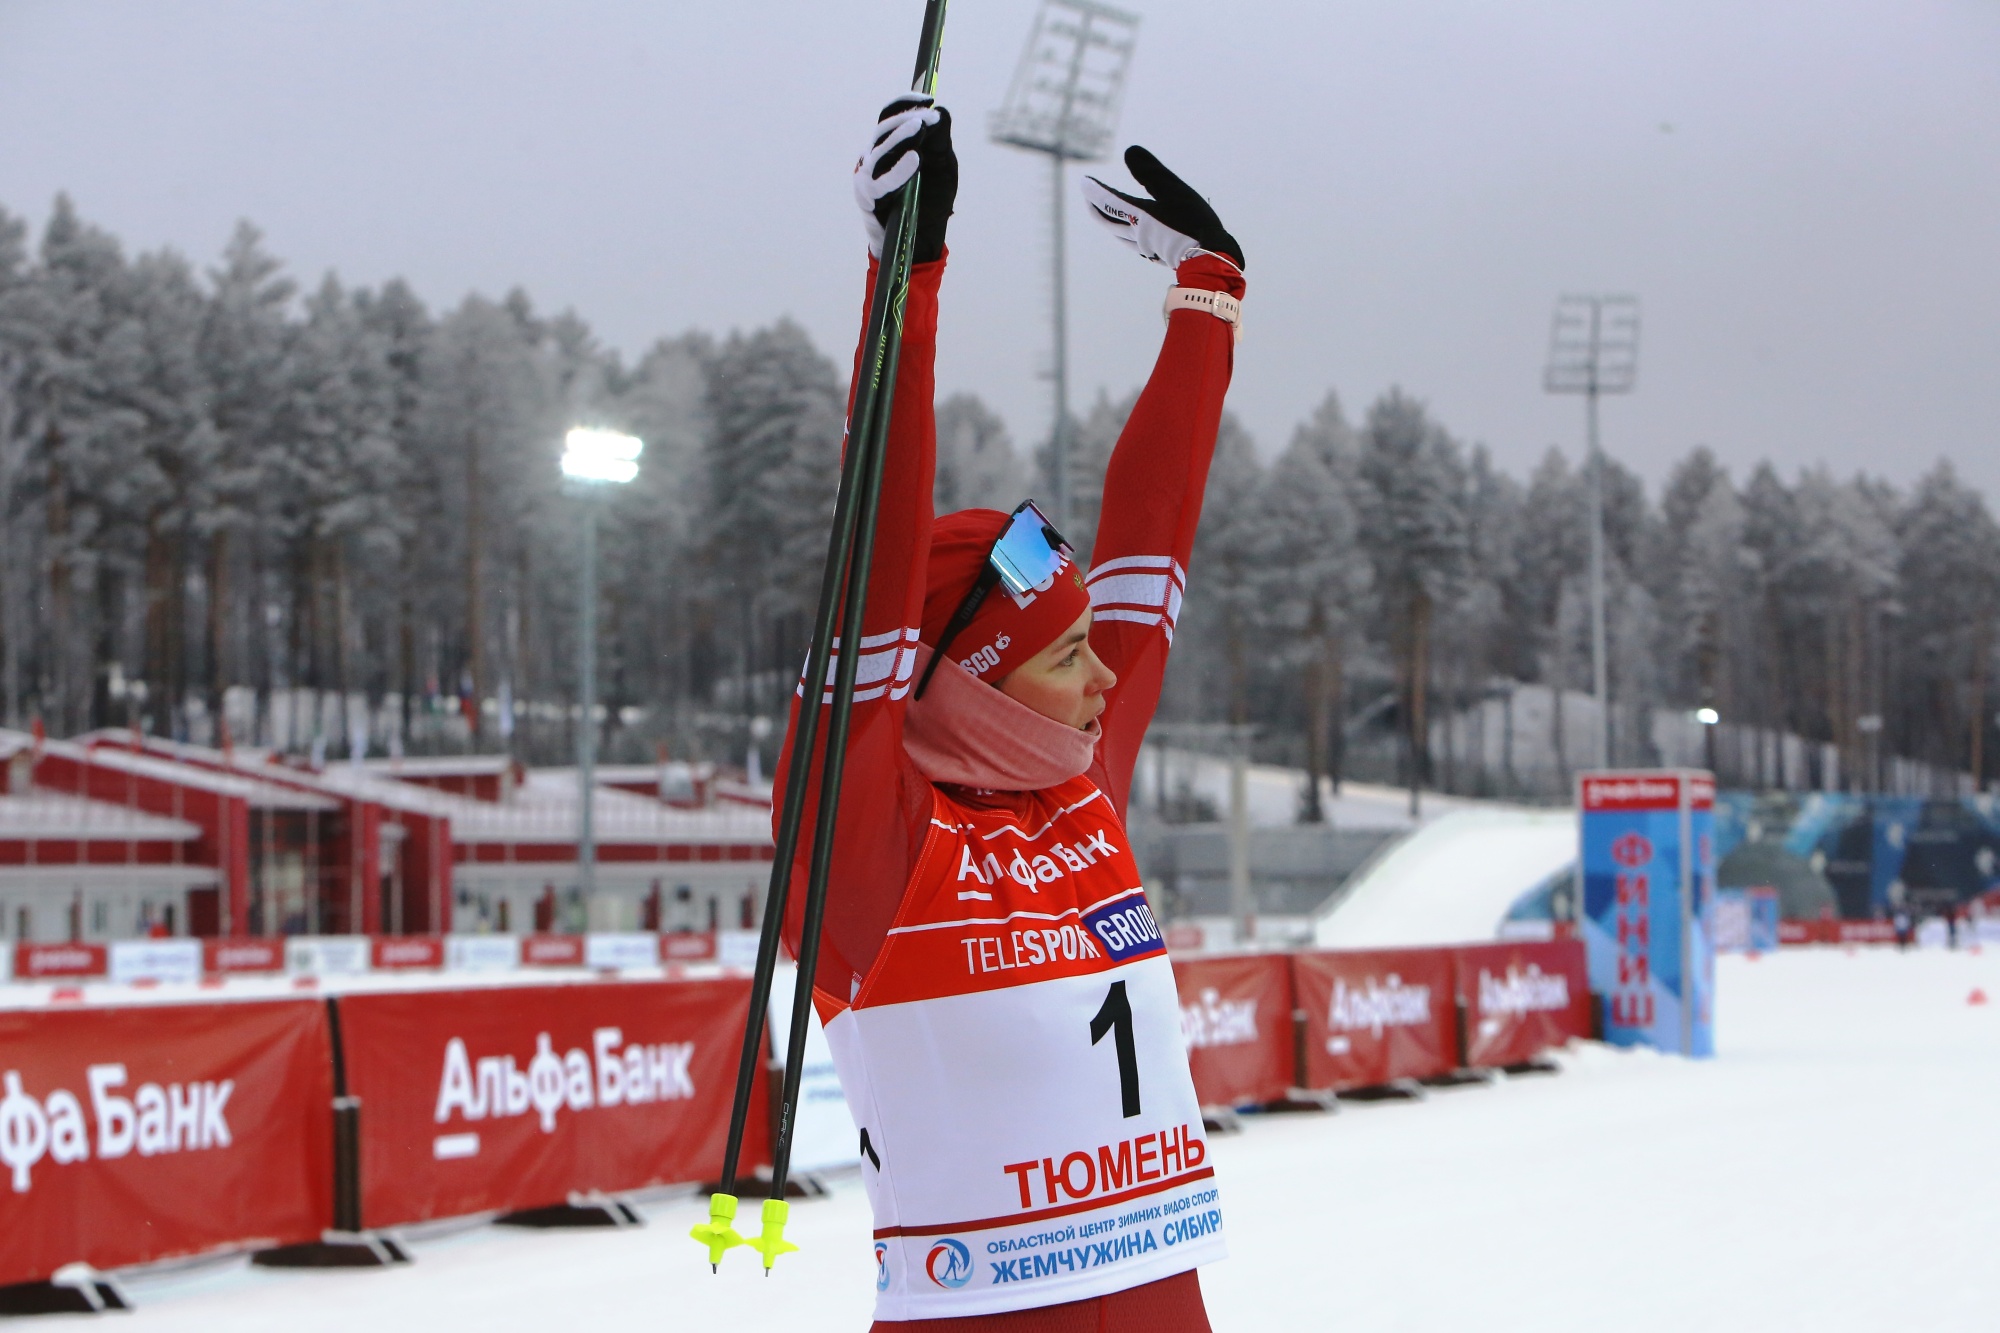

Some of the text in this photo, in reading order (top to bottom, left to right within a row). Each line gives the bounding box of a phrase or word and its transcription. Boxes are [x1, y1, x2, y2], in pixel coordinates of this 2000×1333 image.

[1611, 833, 1654, 1027] ФИНИШ
[1090, 980, 1141, 1118] 1
[1004, 1124, 1205, 1209] ТЮМЕНЬ
[986, 1226, 1075, 1254] ОБЛАСТНОЙ
[1079, 1219, 1115, 1239] ЦЕНТР
[1118, 1208, 1161, 1228] ЗИМНИХ
[1163, 1197, 1191, 1216] ВИДОВ
[990, 1208, 1223, 1284] ЖЕМЧУЖИНА СИБИР
